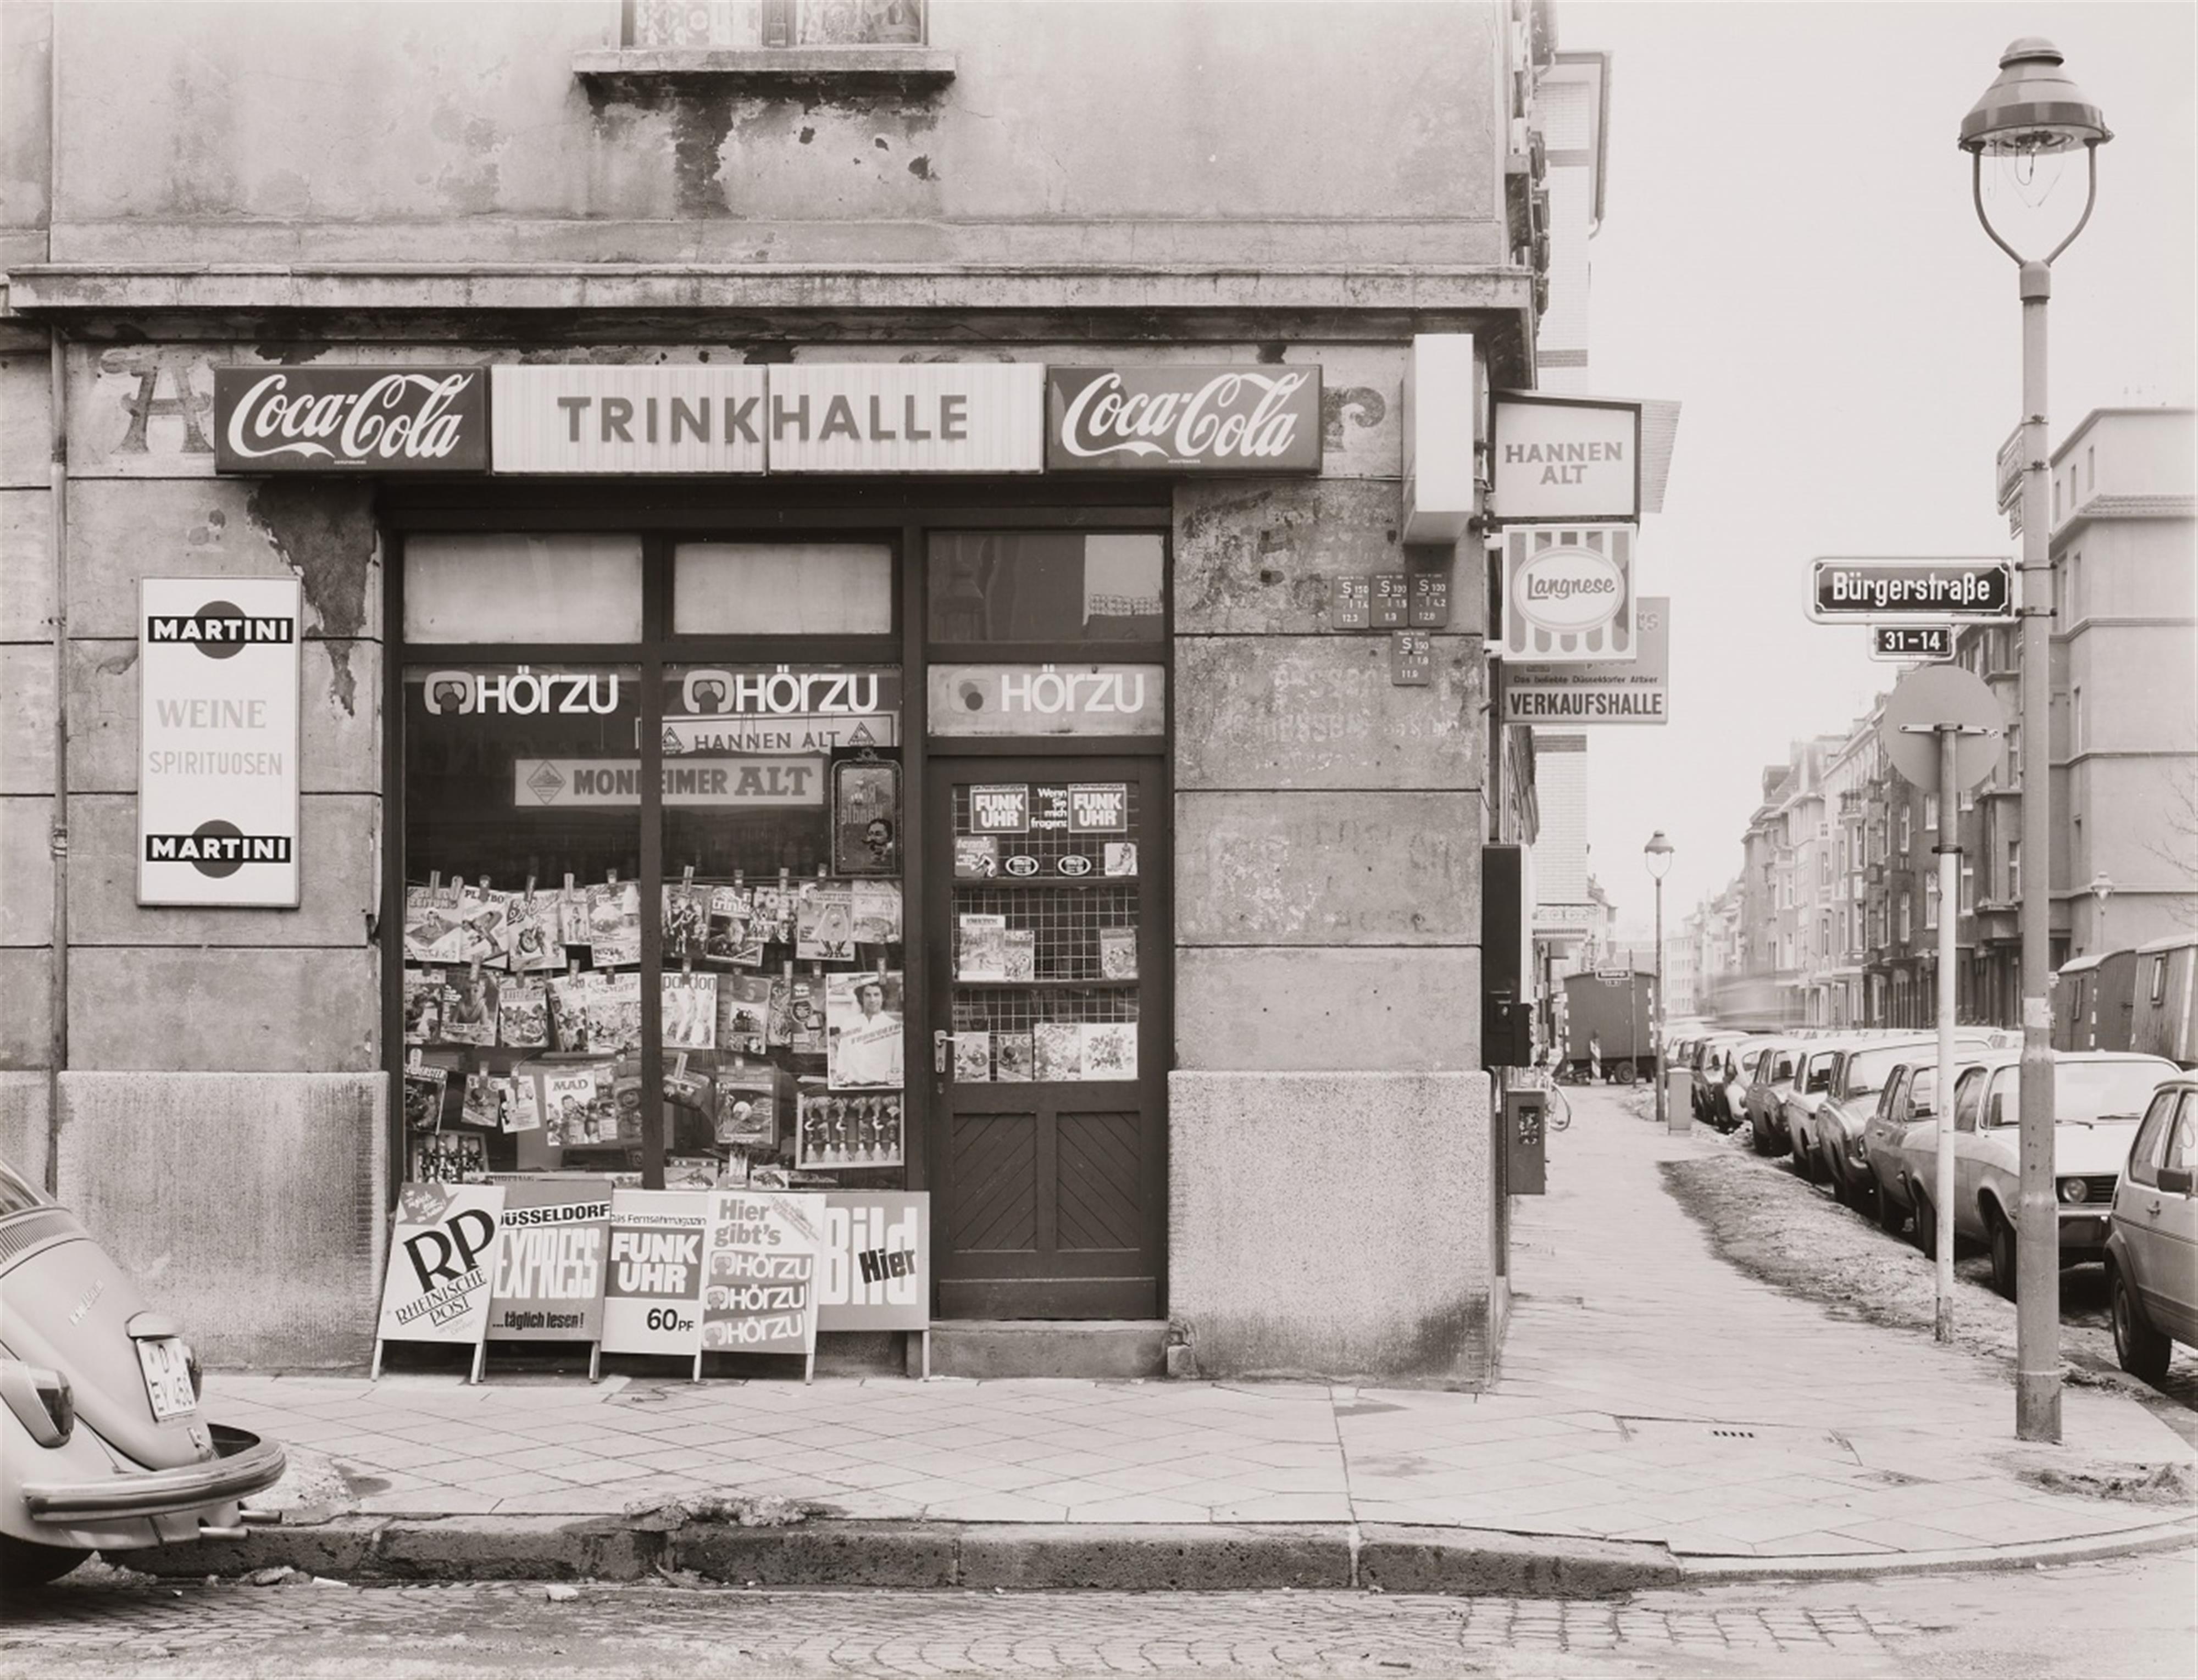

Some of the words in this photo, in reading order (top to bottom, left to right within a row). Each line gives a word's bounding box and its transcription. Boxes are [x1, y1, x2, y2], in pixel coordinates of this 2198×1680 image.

[228, 373, 474, 459] Coca-Cola
[557, 395, 967, 443] TRINKHALLE
[1062, 372, 1310, 457] Coca-Cola
[1506, 442, 1623, 463] HANNEN
[1540, 465, 1588, 485] ALT
[1342, 581, 1351, 594] S
[1381, 580, 1390, 593] S
[1419, 579, 1429, 592] S
[1527, 574, 1615, 600] Langnese
[1833, 572, 1990, 607] Bürgerstraße
[153, 619, 288, 641] MARTINI
[1885, 631, 1940, 650] 31-14
[1402, 638, 1412, 649] S
[157, 699, 267, 729] WEINE
[1510, 692, 1662, 715] VERKAUFSHALLE
[694, 732, 792, 750] HANNEN
[801, 731, 841, 748] ALT
[149, 750, 282, 776] SPIRITUOSEN
[735, 766, 812, 796] ALT
[976, 794, 1024, 810] FUNK
[1074, 794, 1122, 810] FUNK
[981, 810, 1019, 827] UHR
[1079, 810, 1118, 827] UHR
[152, 837, 287, 859] MARTINI
[552, 1079, 589, 1092] MAD
[719, 1199, 769, 1221] Hier
[714, 1223, 781, 1248] gibt's
[403, 1209, 495, 1293] RP
[612, 1232, 698, 1265] FUNK
[493, 1228, 600, 1299] EXPRESS
[858, 1248, 916, 1284] Hier
[618, 1262, 688, 1293] UHR
[395, 1267, 487, 1326] RHEINISCHE
[430, 1297, 473, 1327] POST
